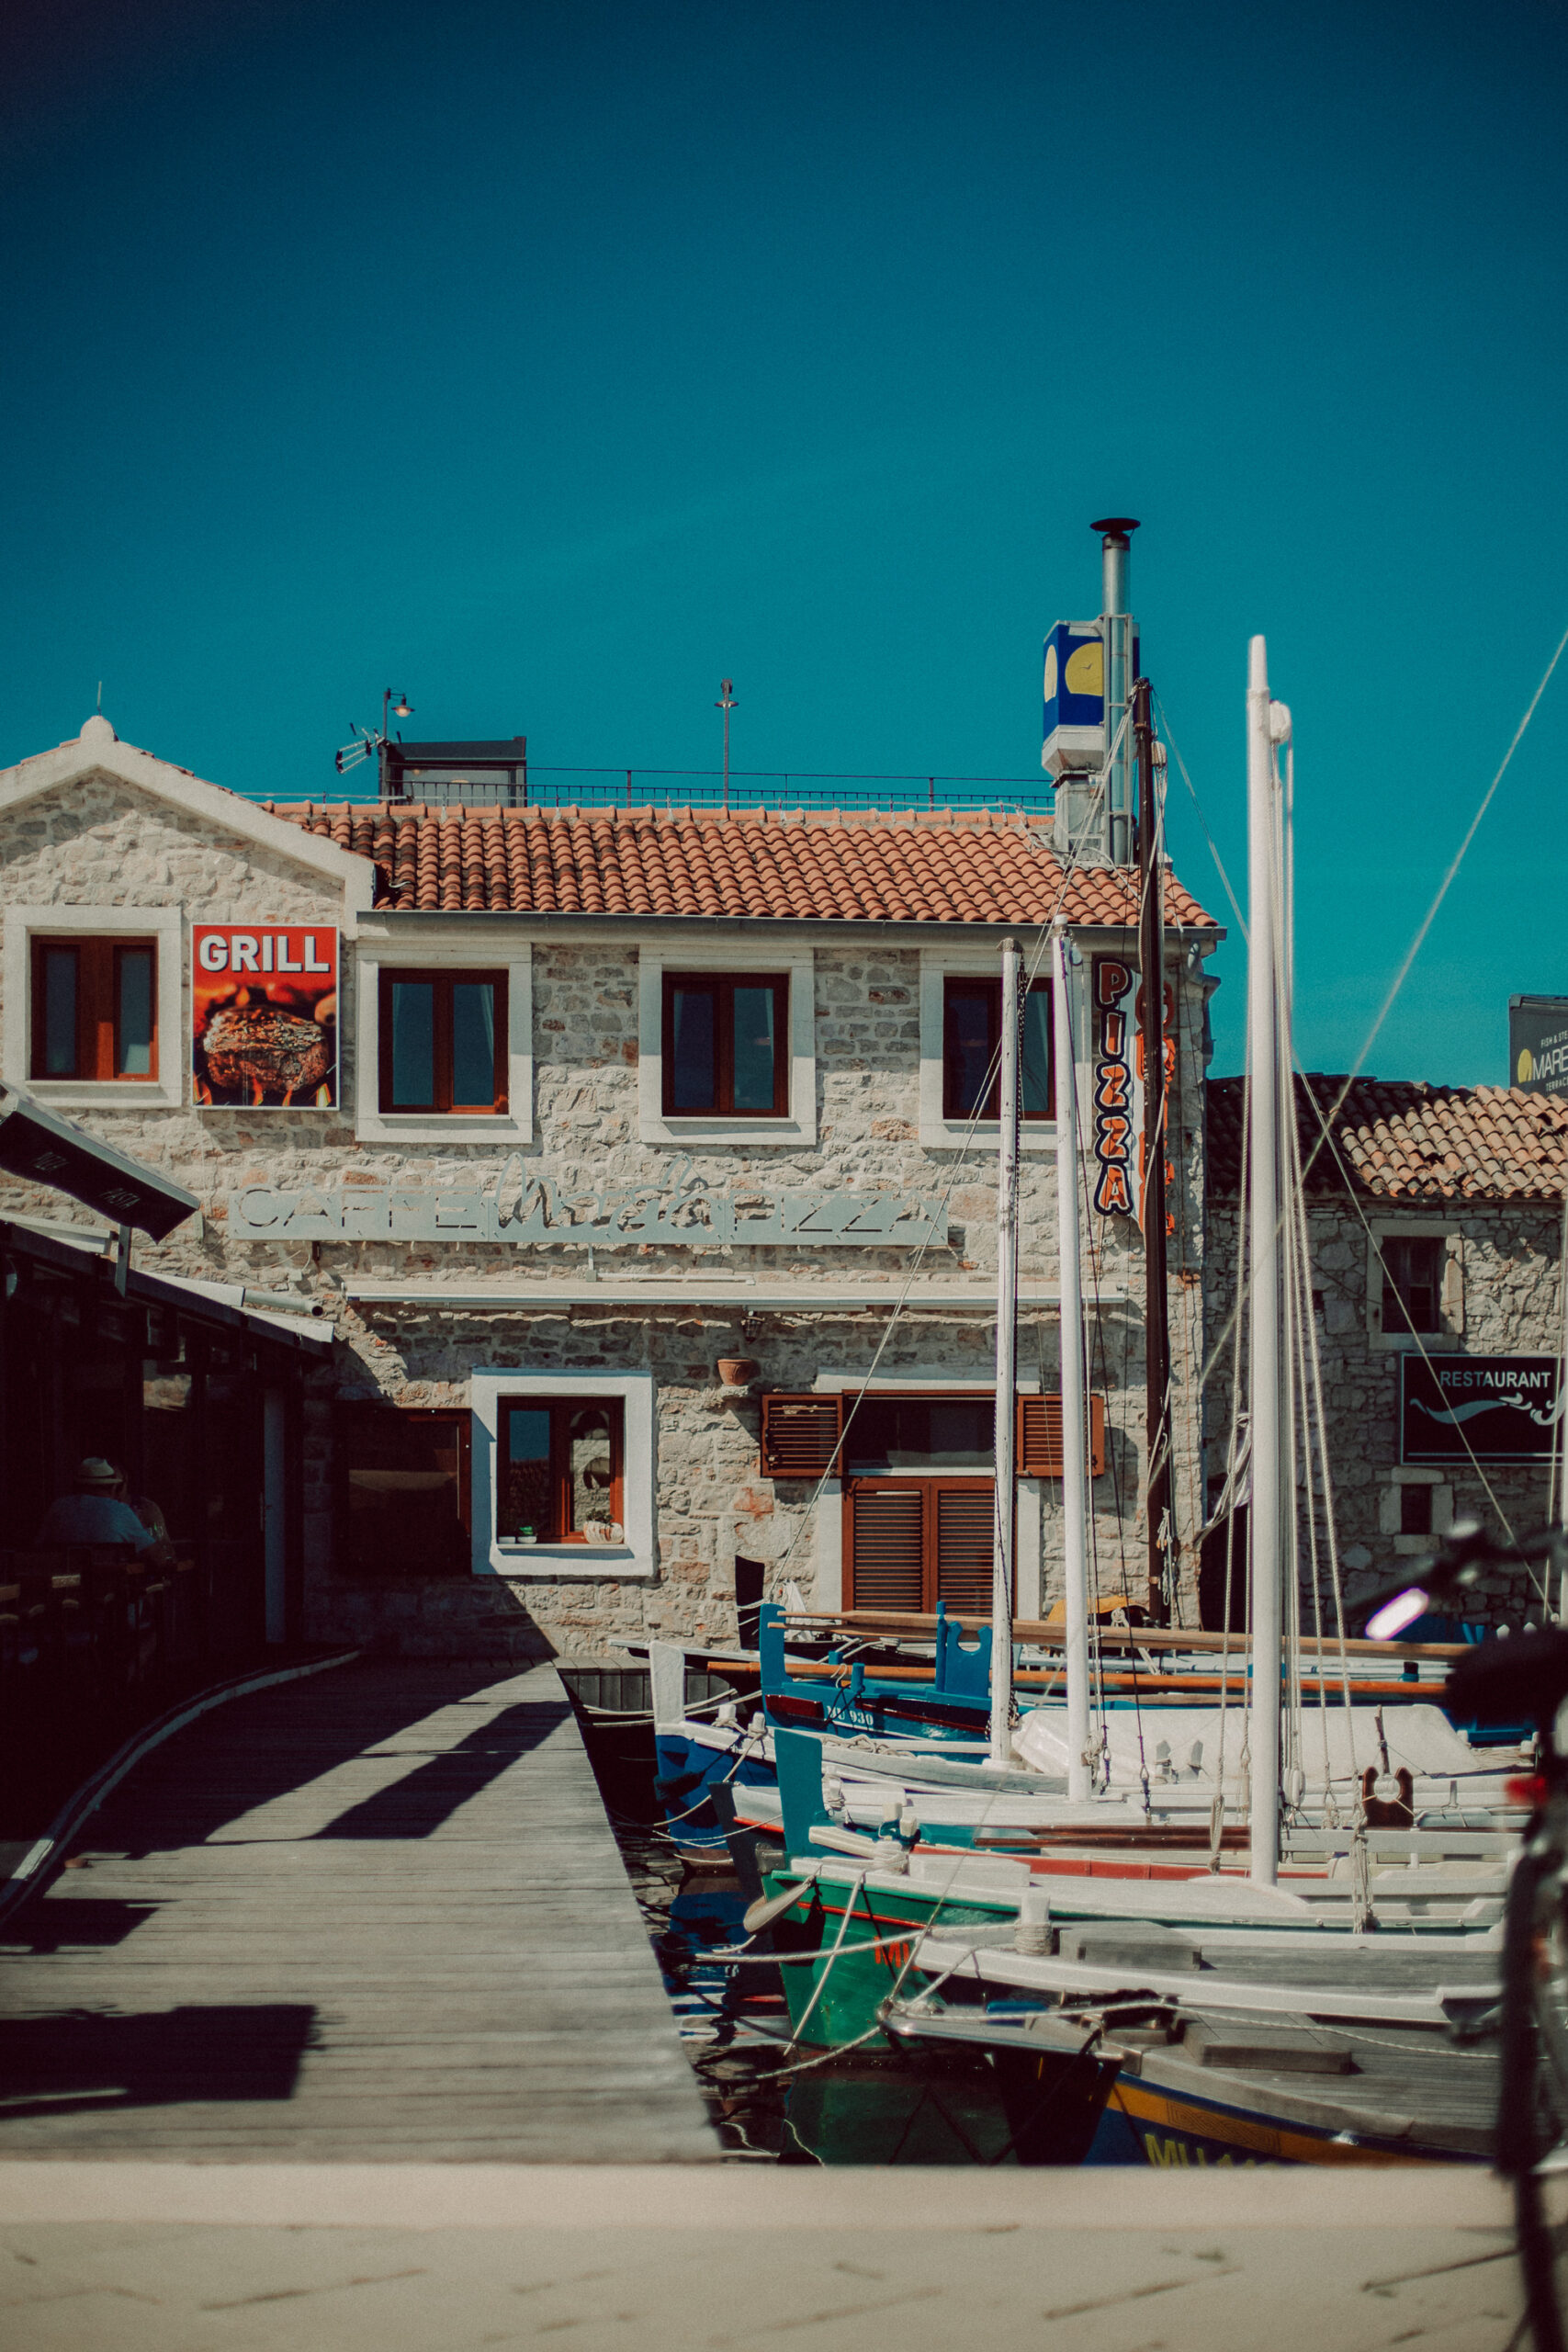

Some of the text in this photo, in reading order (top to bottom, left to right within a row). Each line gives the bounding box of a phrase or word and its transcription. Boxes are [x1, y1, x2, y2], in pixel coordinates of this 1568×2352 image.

[199, 934, 331, 973] GRILL
[1540, 1035, 1553, 1048] FISH
[1094, 957, 1133, 1216] PIZZA
[1546, 1075, 1568, 1091] TERRAC
[238, 1183, 479, 1228] CAFFE
[733, 1192, 941, 1234] PIZZA
[1439, 1371, 1551, 1388] RESTAURANT
[850, 1710, 874, 1725] 930
